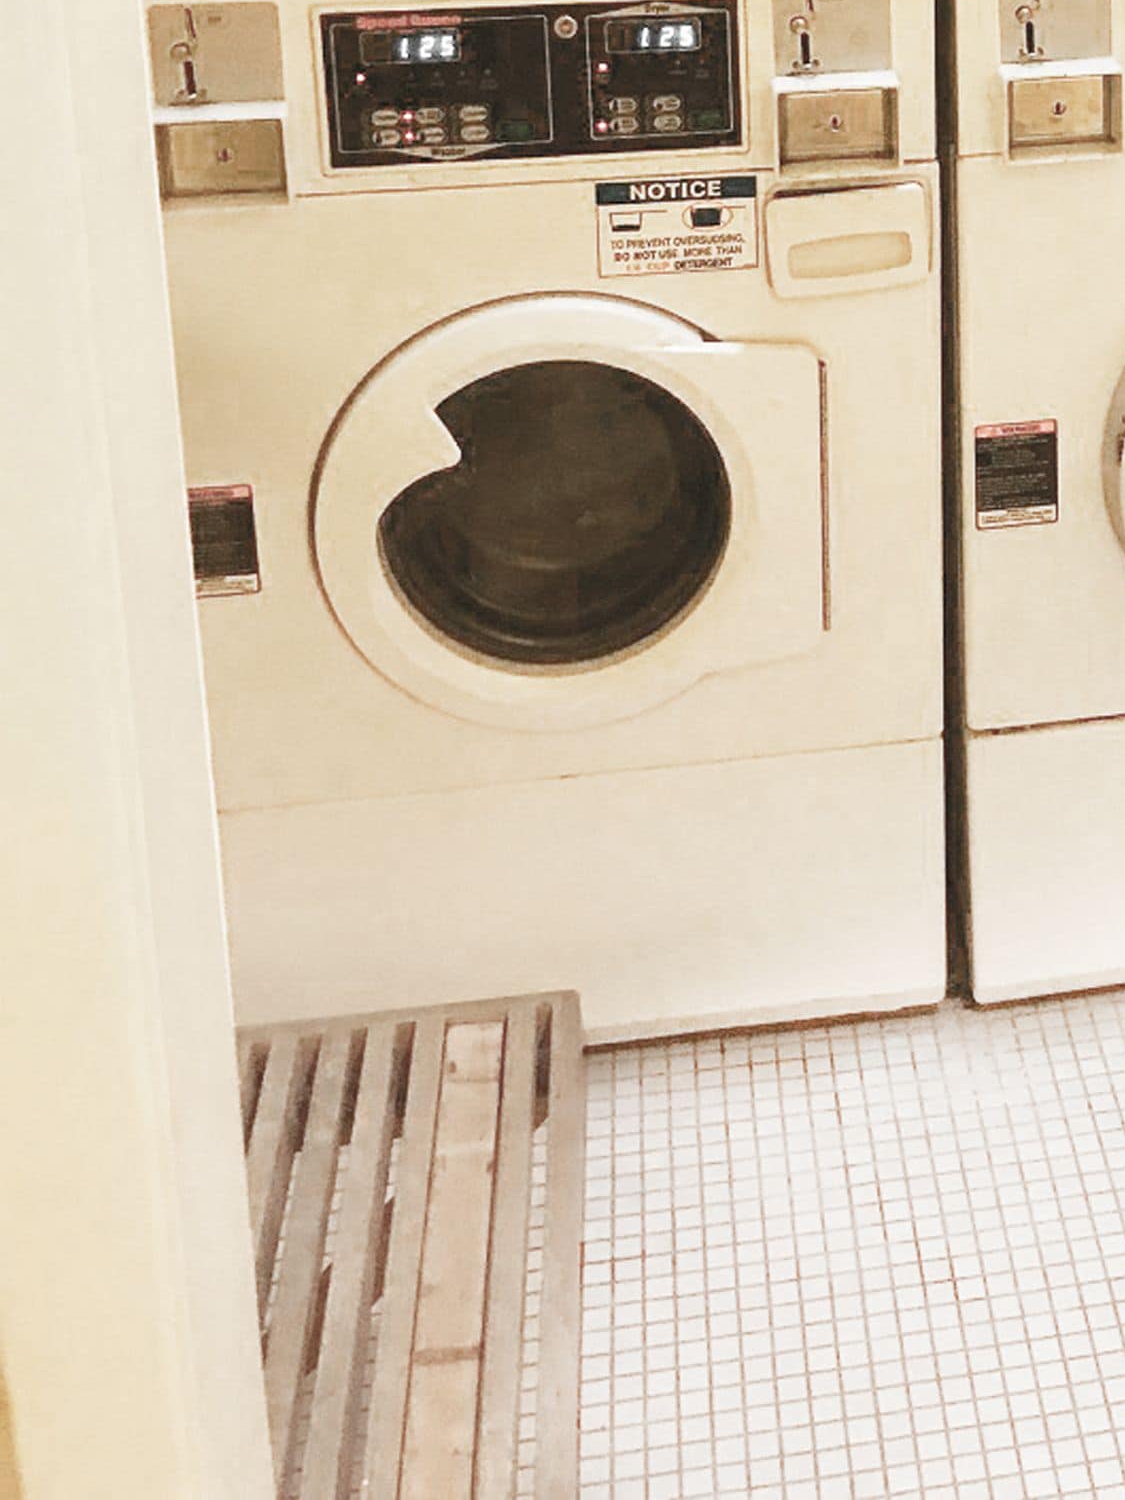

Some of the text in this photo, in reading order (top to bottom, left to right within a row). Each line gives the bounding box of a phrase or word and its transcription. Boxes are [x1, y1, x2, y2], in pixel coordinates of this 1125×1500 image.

[629, 179, 722, 200] NOTICE
[610, 240, 625, 249] TO
[626, 237, 671, 249] PREVENT
[614, 246, 742, 262] DO NOT USE MORE THAN
[674, 257, 733, 269] DETERGENT
